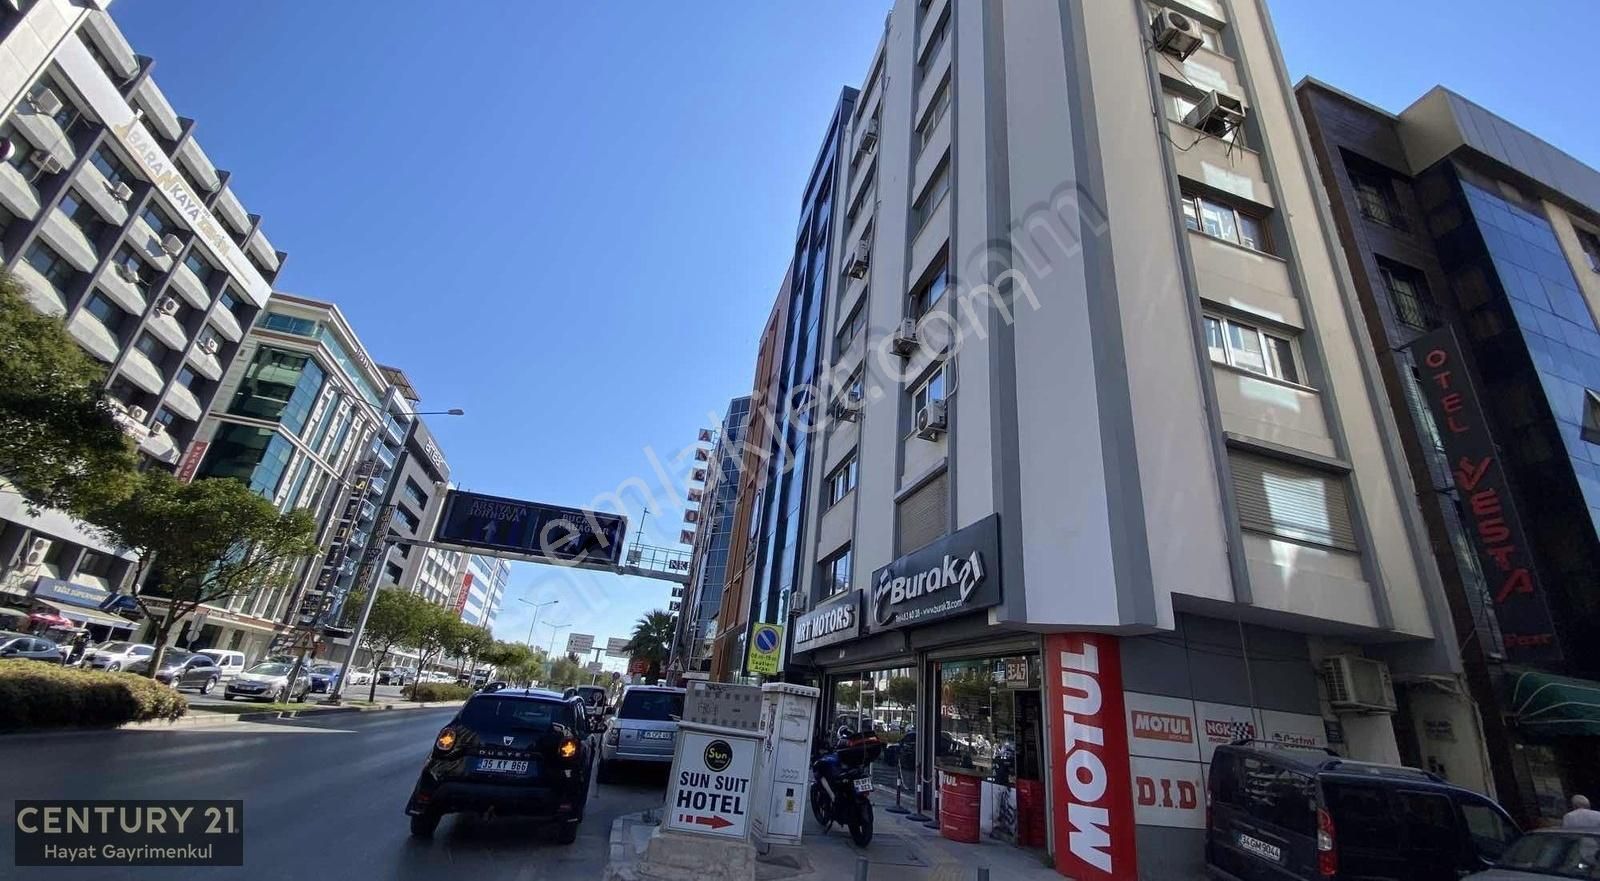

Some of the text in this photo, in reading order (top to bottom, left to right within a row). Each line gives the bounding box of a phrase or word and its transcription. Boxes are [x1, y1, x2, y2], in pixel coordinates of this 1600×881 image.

[681, 428, 713, 545] ANEMON
[1426, 350, 1470, 433] OTEL
[1454, 456, 1534, 603] VESTA
[812, 607, 852, 640] MOTORS
[1135, 713, 1189, 735] MOTUL
[1206, 720, 1231, 737] NGK
[481, 760, 493, 769] 35
[497, 761, 508, 770] KY
[708, 748, 728, 760] Sun
[1060, 642, 1113, 874] MOTUL
[680, 771, 749, 793] SUN SUIT
[1136, 776, 1197, 810] D.I.D
[677, 789, 745, 815] HOTEL
